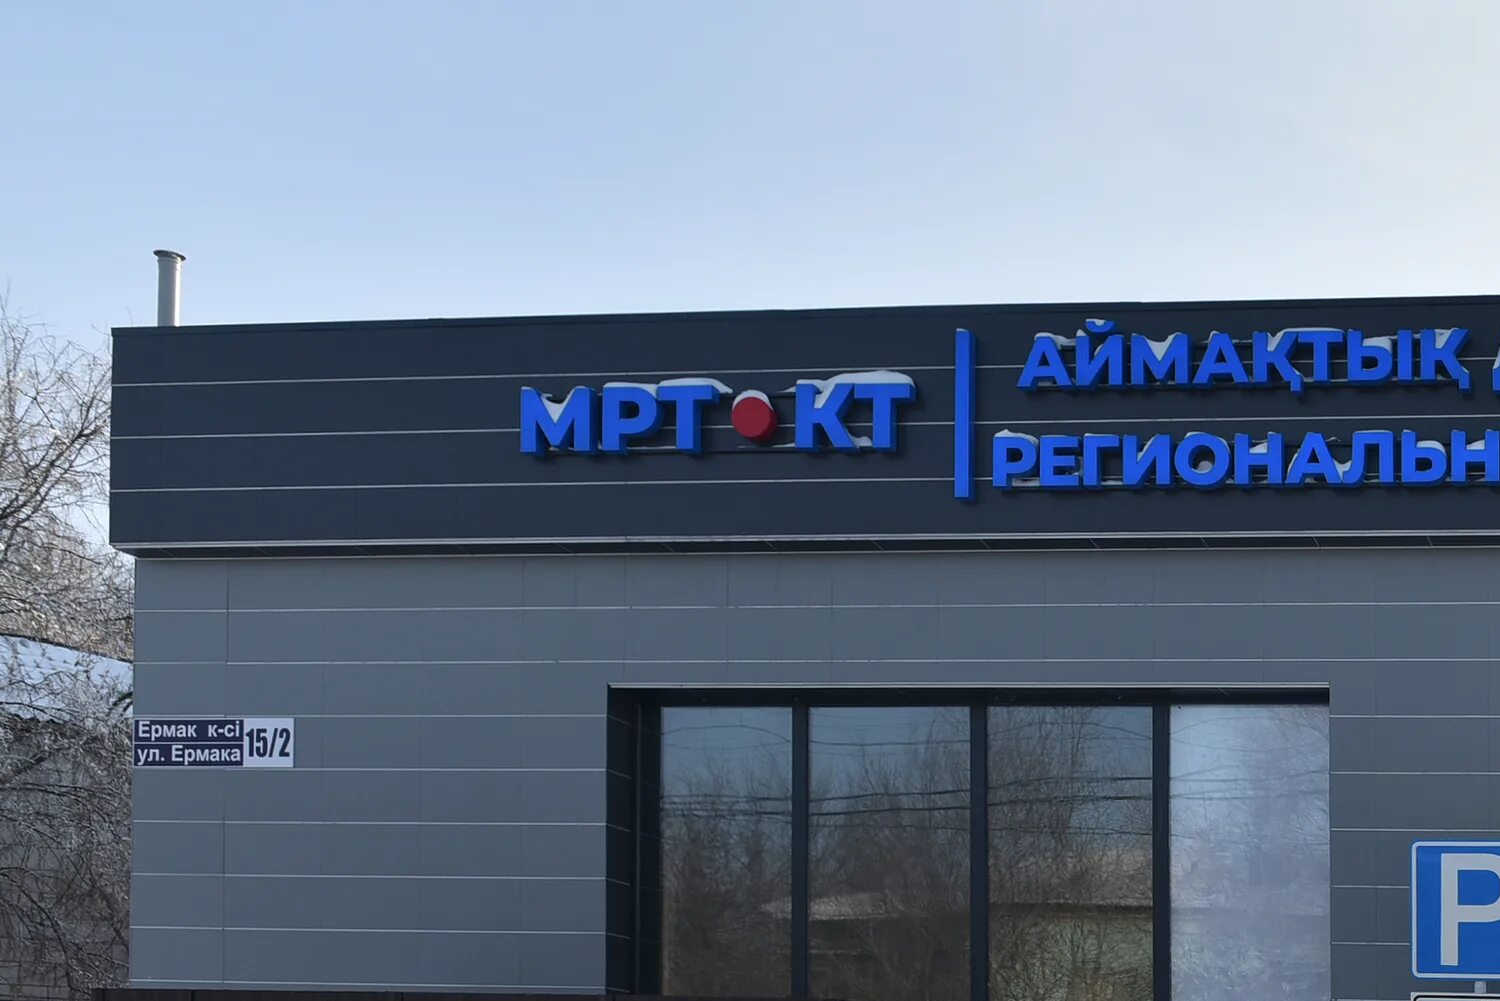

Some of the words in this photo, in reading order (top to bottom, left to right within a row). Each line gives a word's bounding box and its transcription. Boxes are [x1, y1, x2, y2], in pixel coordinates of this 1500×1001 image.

[1017, 319, 1469, 393] АЙМАҚТЫҚ
[520, 384, 722, 453] МРТ
[795, 380, 916, 451] КТ
[138, 720, 197, 741] Ермак
[207, 720, 240, 737] к-сі
[245, 728, 291, 758] 15/2
[137, 748, 165, 765] ул.
[171, 745, 241, 765] Ермака
